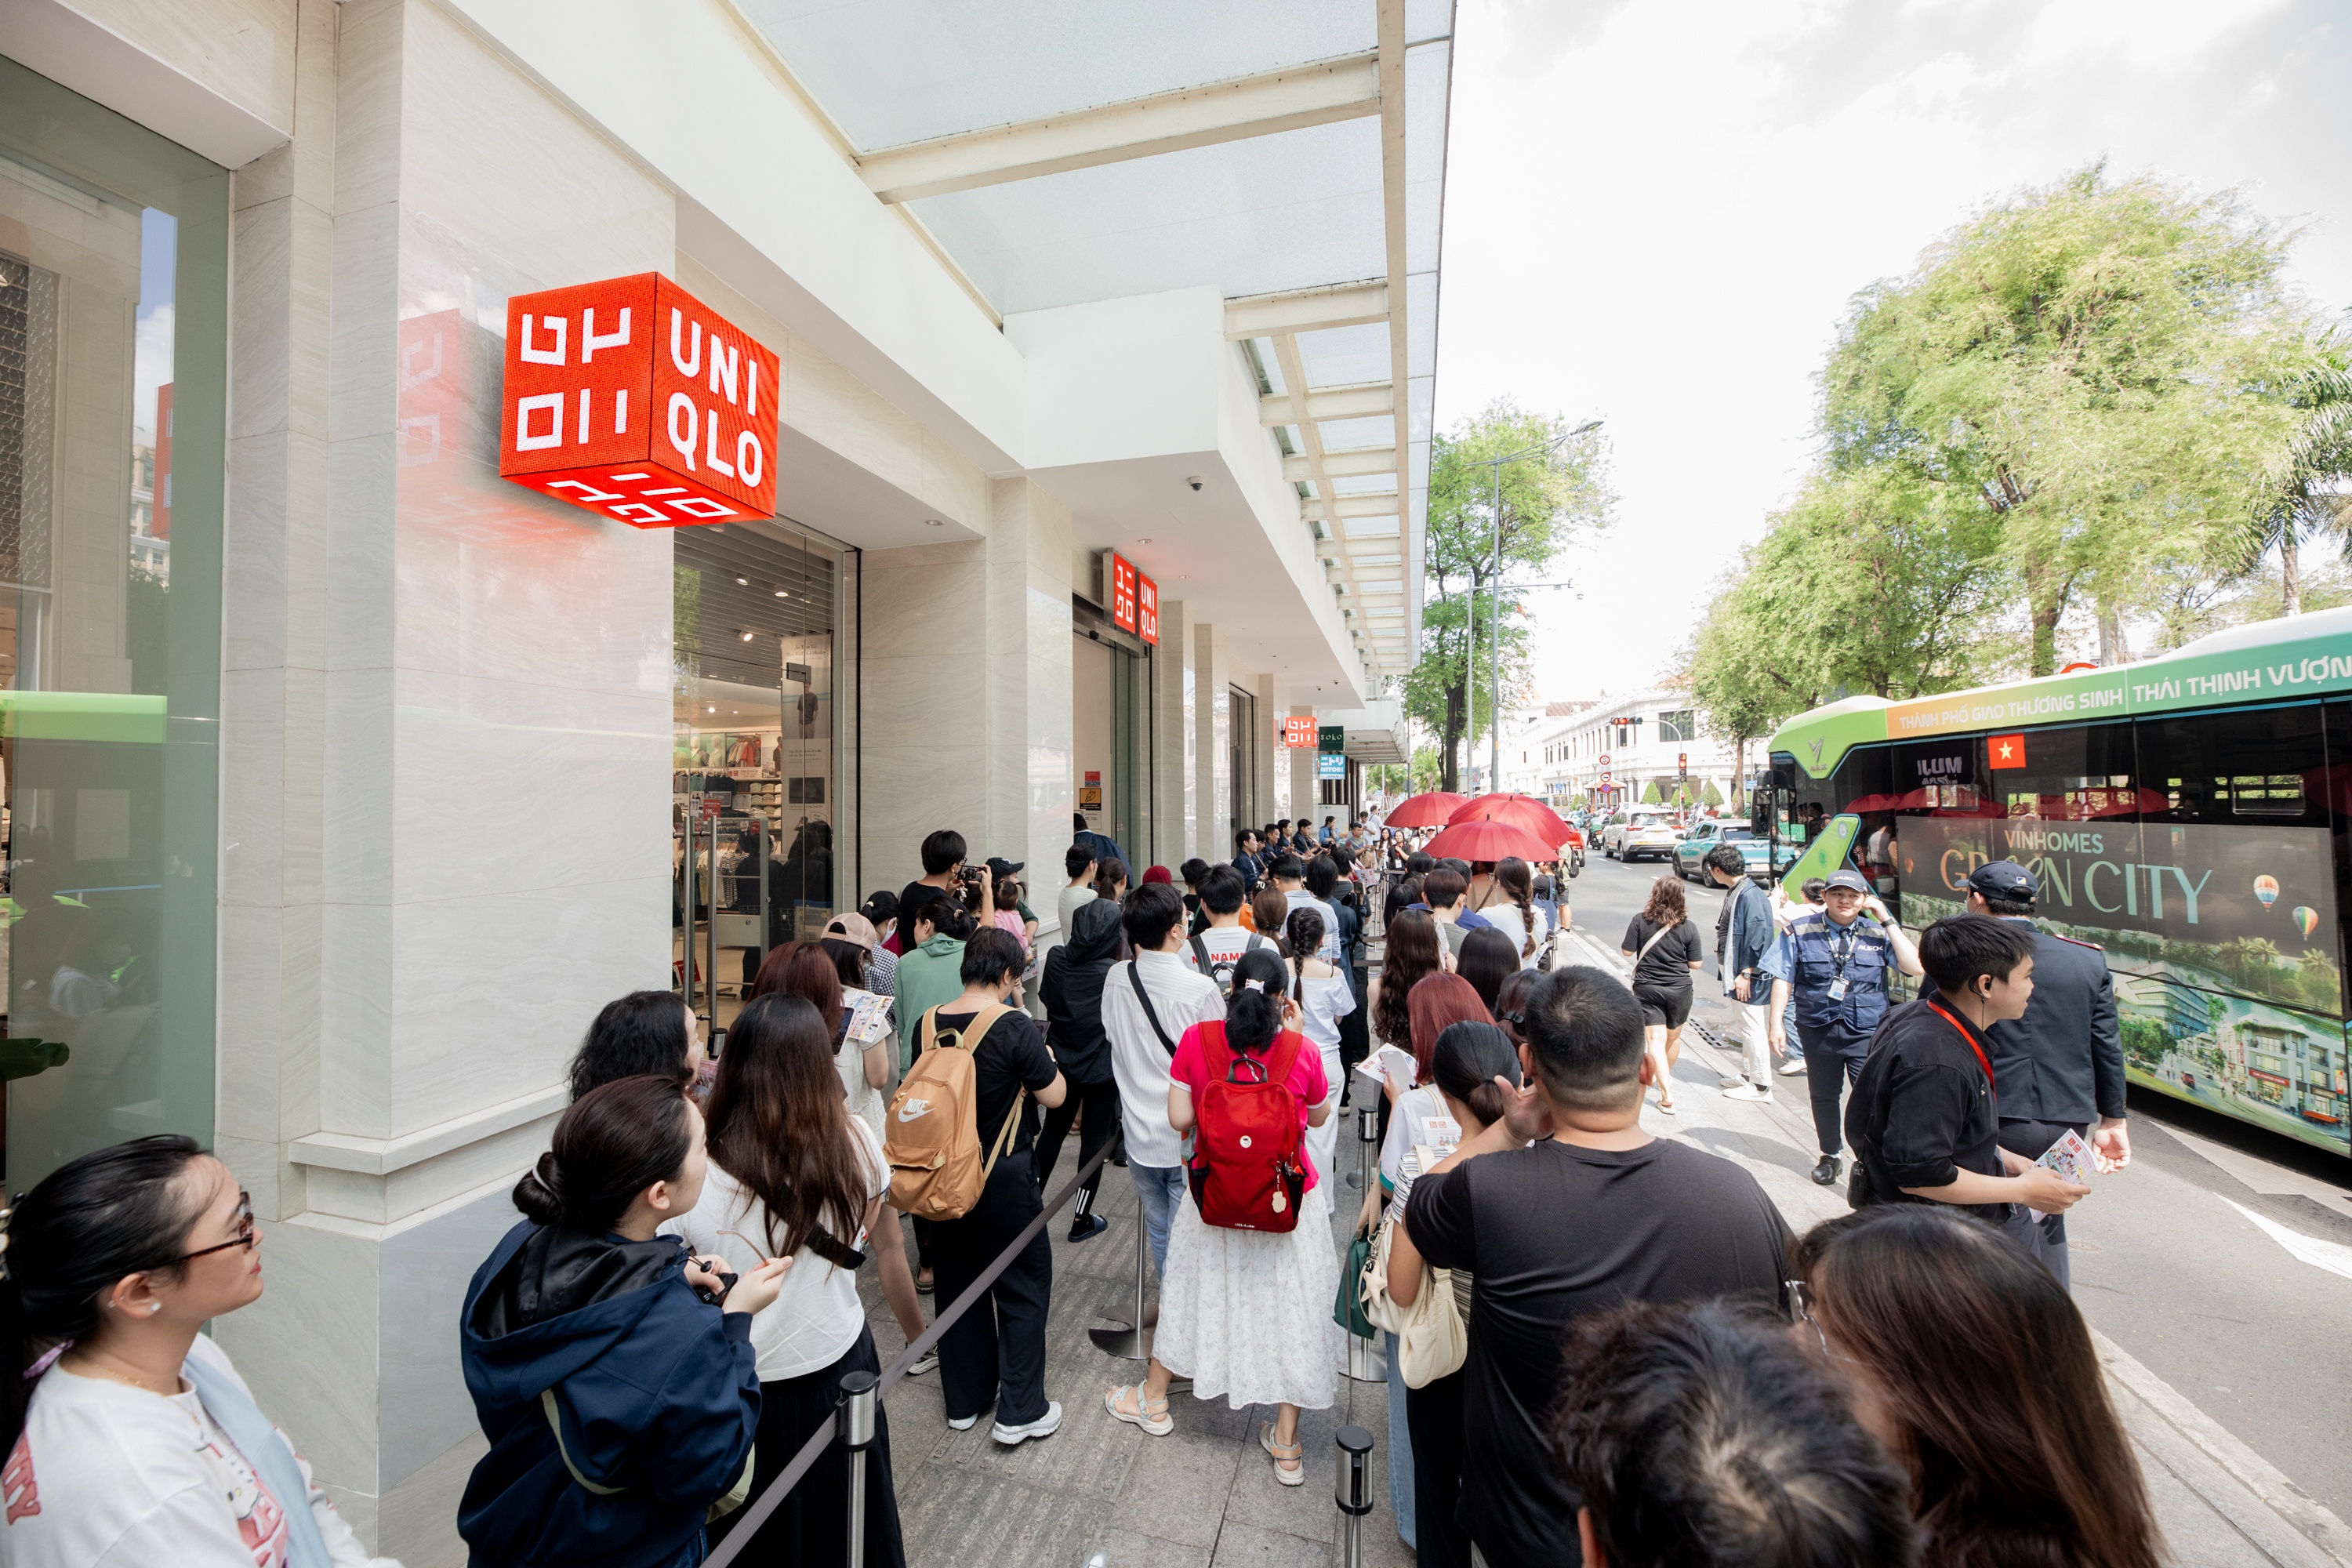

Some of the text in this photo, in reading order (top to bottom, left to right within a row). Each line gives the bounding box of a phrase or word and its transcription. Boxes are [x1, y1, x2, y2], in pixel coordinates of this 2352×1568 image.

[671, 307, 757, 416] UNI
[667, 392, 763, 488] QLO
[1116, 564, 1133, 596] ユニ
[1116, 593, 1133, 624] クロ
[1141, 582, 1155, 612] UNI
[1141, 609, 1156, 637] QLO
[2132, 677, 2180, 703] THÁI
[2186, 668, 2261, 696] THỊNH
[1899, 688, 2123, 730] THÀNH PHỐ GIAO THƯƠNG SINH
[1320, 757, 1344, 766] ニトリ
[2004, 829, 2104, 855] VINHOMES
[2084, 860, 2213, 924] CITY
[903, 1098, 930, 1112] NIKE
